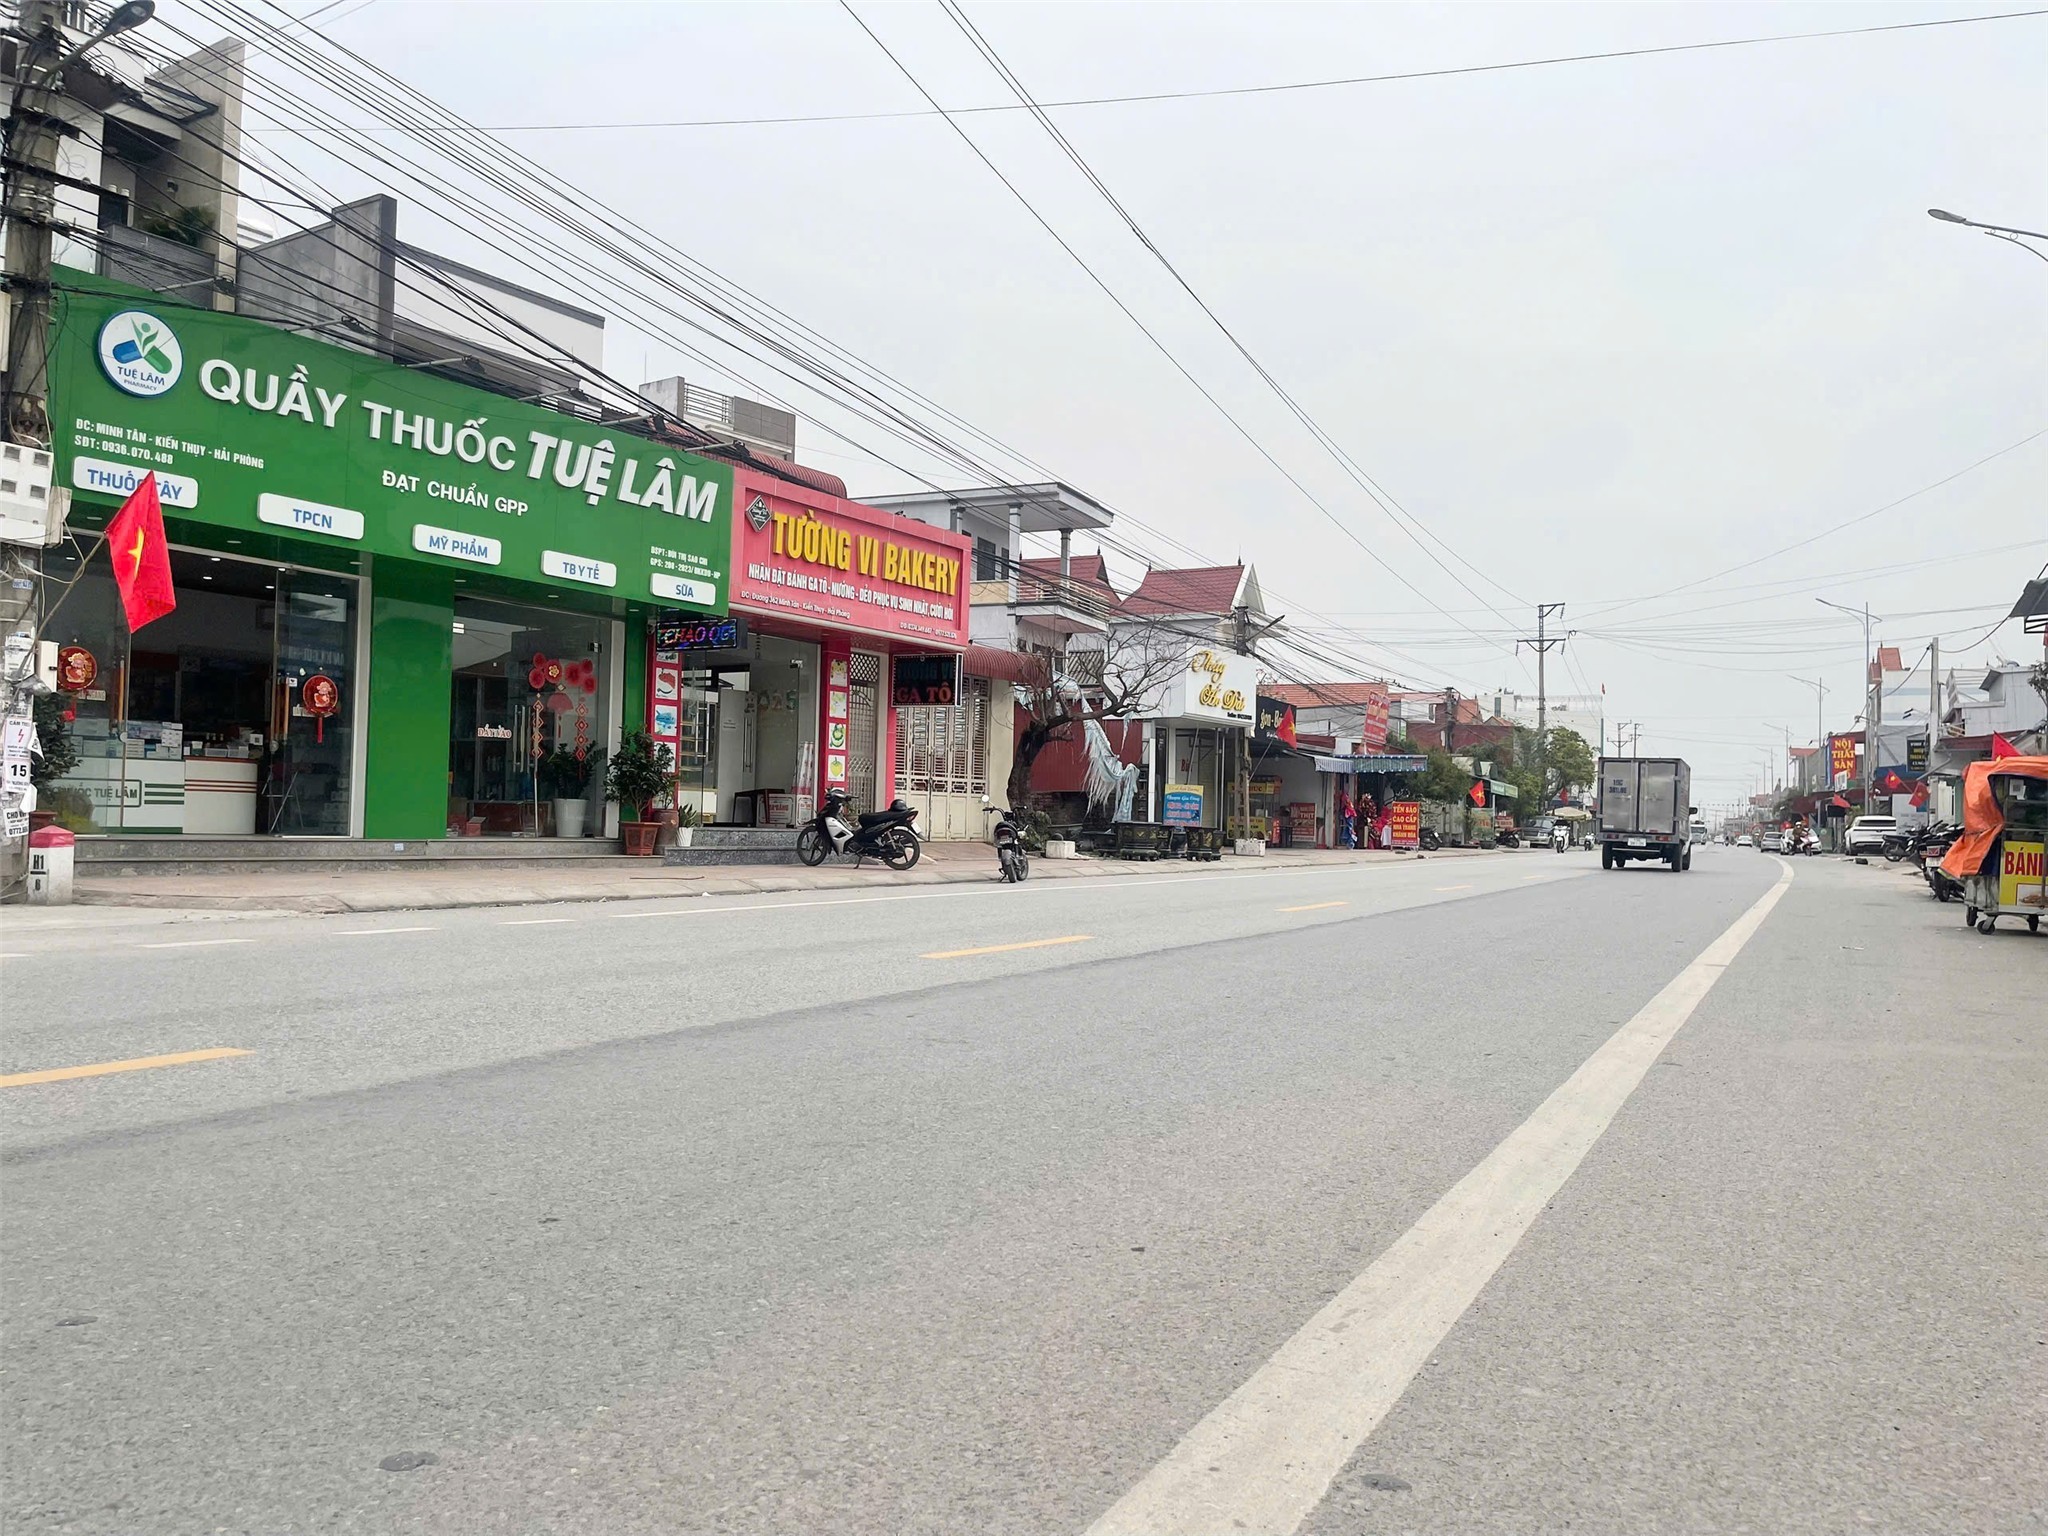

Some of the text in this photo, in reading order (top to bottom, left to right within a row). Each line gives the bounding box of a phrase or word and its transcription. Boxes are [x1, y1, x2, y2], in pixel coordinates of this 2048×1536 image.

[118, 366, 165, 386] TUỆ LÂM
[124, 379, 157, 391] PHARMACY
[74, 434, 174, 465] SĐT: 0936.070.488
[76, 418, 264, 469] ĐC: MINH TÂN KIẾN THỤY HẢI PHÒNG
[199, 358, 719, 523] QUẦY THUỐC TUỆ LÂM
[382, 470, 529, 517] ĐẠT CHUẨN GPP
[293, 508, 332, 529] TPCN
[429, 535, 488, 559] MỸ PHẨM
[771, 509, 960, 596] TƯỜNG VI BAKERY
[563, 562, 600, 580] TB Y TẾ
[675, 584, 694, 598] SỮA
[748, 562, 771, 584] NHẬN
[771, 566, 786, 588] ĐẶT
[786, 570, 808, 590] BÁNH
[808, 576, 818, 592] GA
[818, 576, 828, 594] TÔ
[831, 580, 855, 600] NƯỚNG
[873, 591, 889, 609] PHỤC
[899, 596, 913, 613] SINH
[896, 681, 952, 702] GA TÔ
[1831, 749, 1856, 759] THẤT
[1834, 738, 1851, 750] NỘI
[11, 764, 27, 777] 15
[6, 811, 19, 820] CHO
